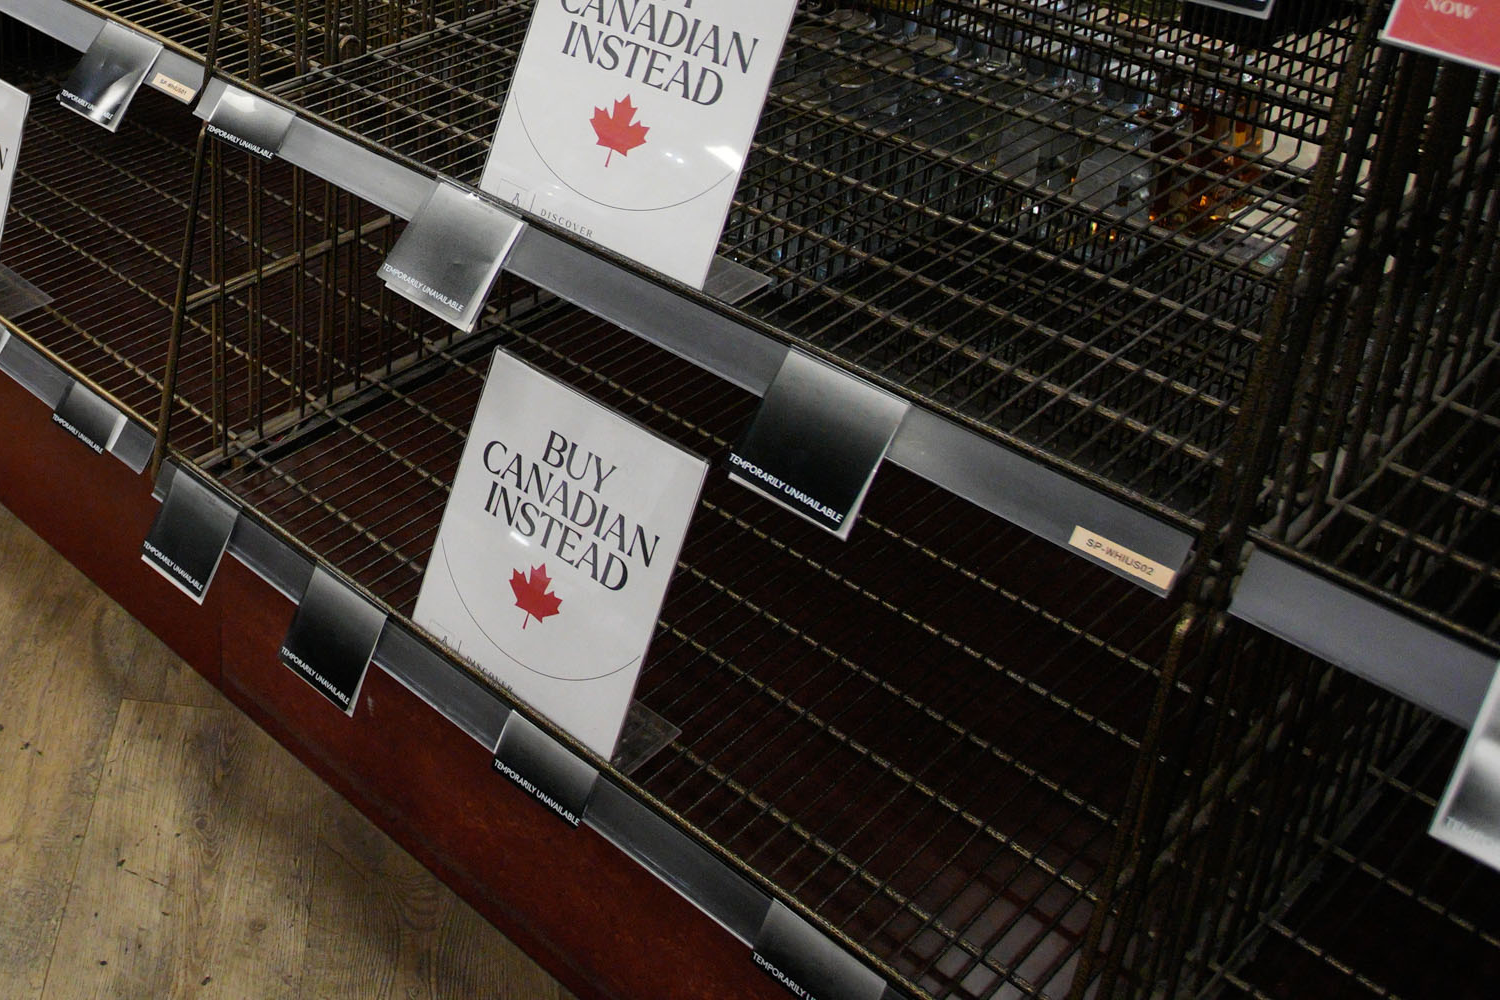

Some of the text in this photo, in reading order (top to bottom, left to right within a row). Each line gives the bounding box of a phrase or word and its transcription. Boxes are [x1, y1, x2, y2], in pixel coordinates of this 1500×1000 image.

[562, 20, 723, 106] INSTEAD
[207, 124, 273, 160] TEMPORARILY UNAVAILABLE
[540, 208, 595, 238] DISCOVER
[383, 263, 465, 312] TEMPORARILY UNAVAILABLE
[52, 412, 104, 454] TEMPORARILY UNAVAILABLE
[542, 430, 618, 494] BUY
[483, 440, 660, 568] CANADIAN
[728, 452, 843, 523] TEMPORARILY UNAVAILABLE
[484, 480, 628, 591] INSTEAD
[143, 540, 203, 592] TEMPORARILY UNAVAILABLE
[281, 646, 350, 705] TEMPORARILY UNAVAILABLE
[494, 758, 581, 827] TEMPORARILY UNAVAILABLE
[753, 951, 807, 997] TEMPORARILY
